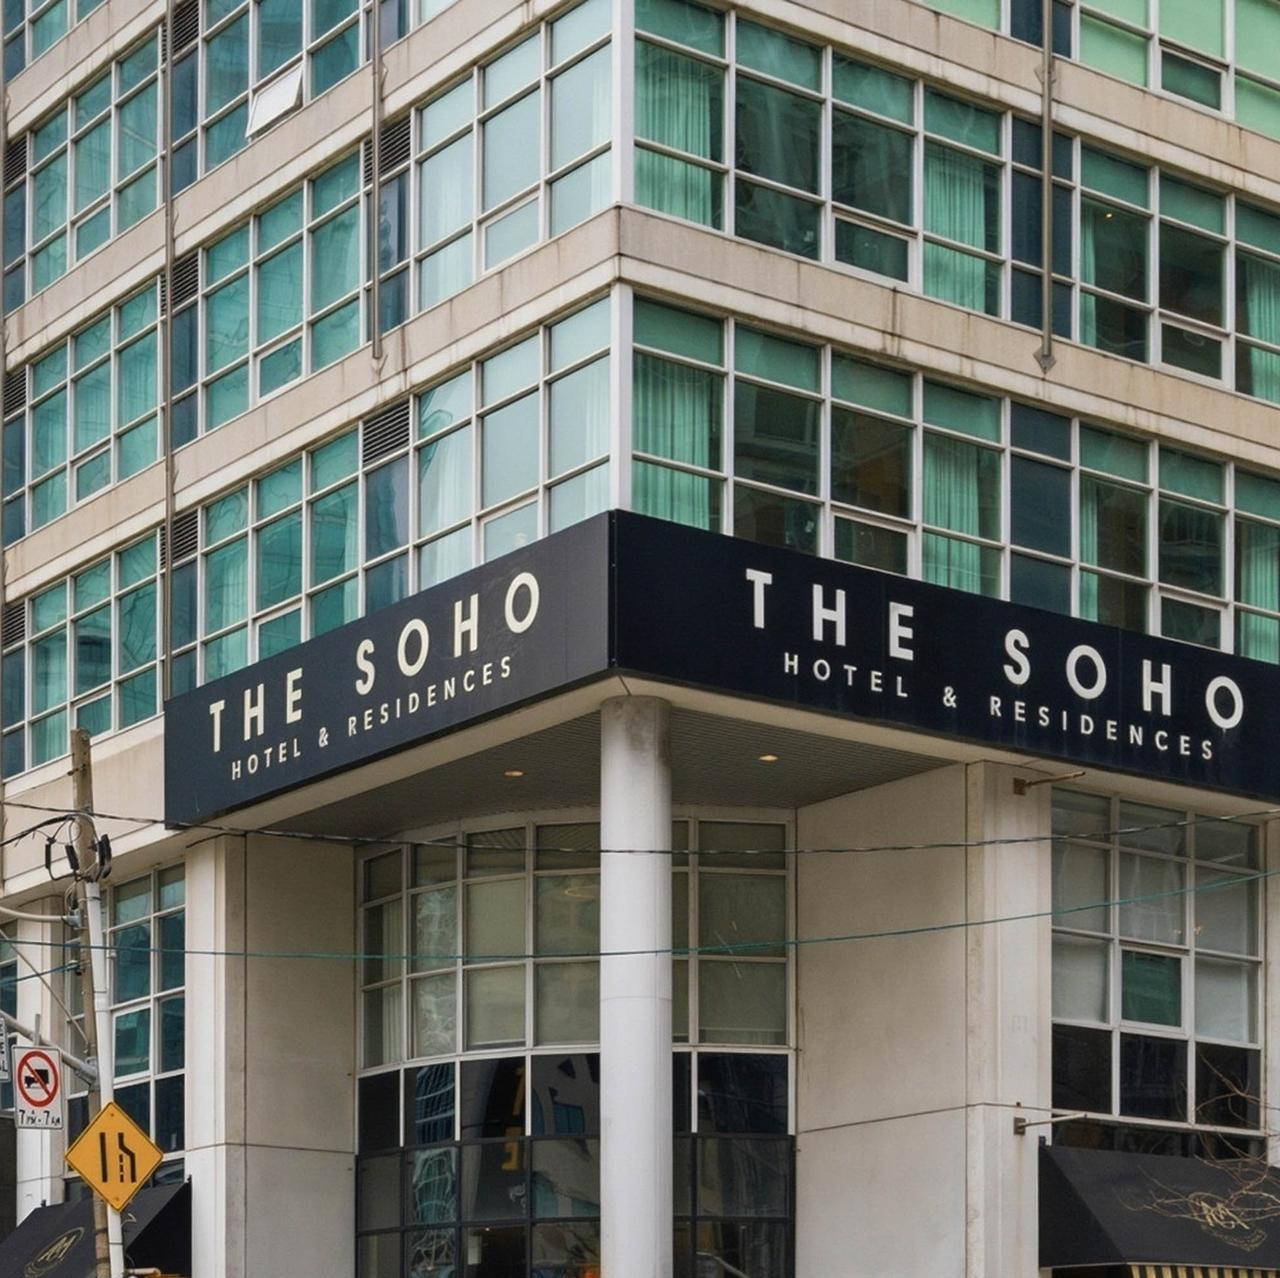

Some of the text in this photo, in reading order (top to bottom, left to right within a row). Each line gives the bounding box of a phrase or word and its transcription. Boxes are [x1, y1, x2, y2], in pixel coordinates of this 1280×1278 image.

[210, 571, 540, 753] THE SOHO
[231, 656, 512, 781] HOTEL & RESIDENCES
[746, 569, 1244, 729] THE SOHO
[784, 652, 1213, 760] HOTEL & RESIDENCES
